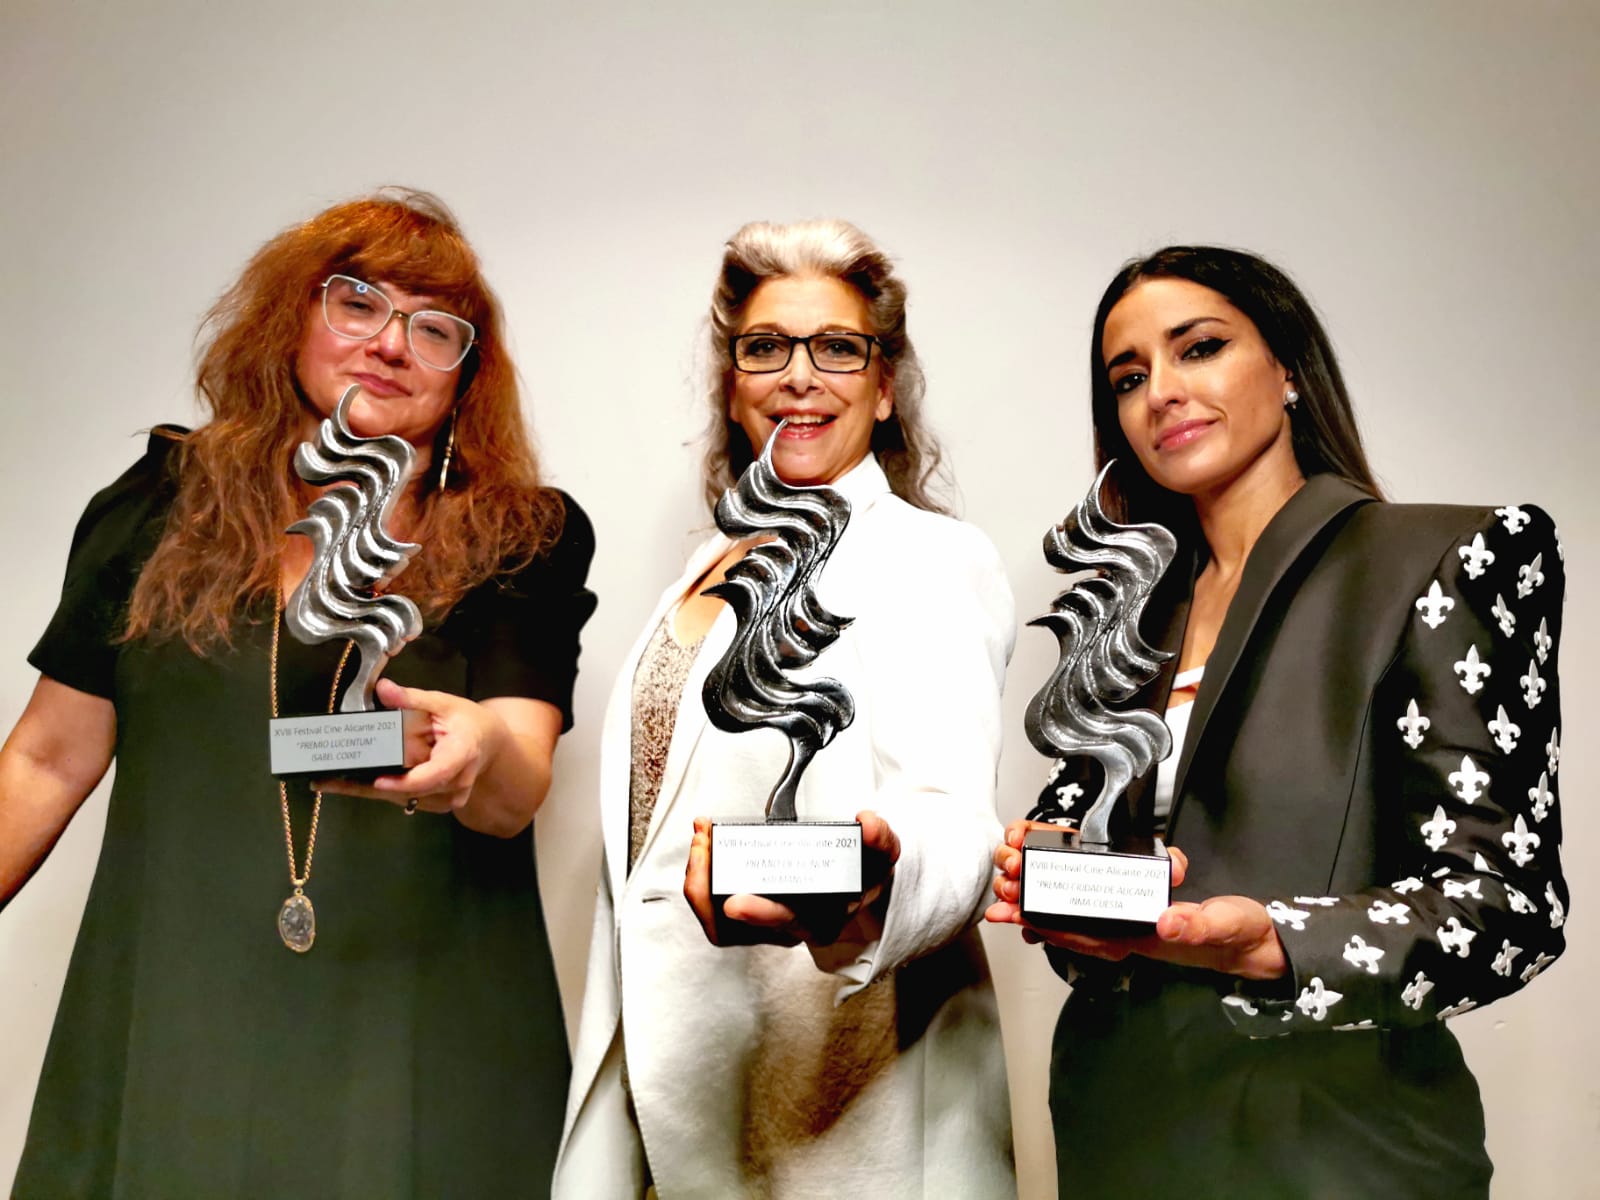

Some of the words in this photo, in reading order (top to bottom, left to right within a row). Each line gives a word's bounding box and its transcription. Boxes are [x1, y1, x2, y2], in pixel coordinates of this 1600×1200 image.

[294, 726, 322, 736] Festival
[324, 725, 341, 734] Cine
[343, 723, 375, 732] Alicante
[377, 721, 396, 730] 2021
[312, 752, 333, 762] ISABEL
[836, 838, 857, 848] 2021
[1051, 862, 1082, 873] Festival
[1084, 864, 1104, 874] Cine
[1106, 865, 1142, 878] Alicante
[1144, 869, 1167, 880] 2021
[1103, 885, 1115, 894] DE
[1069, 897, 1092, 907] INMA
[1093, 899, 1124, 909] CUESTA
